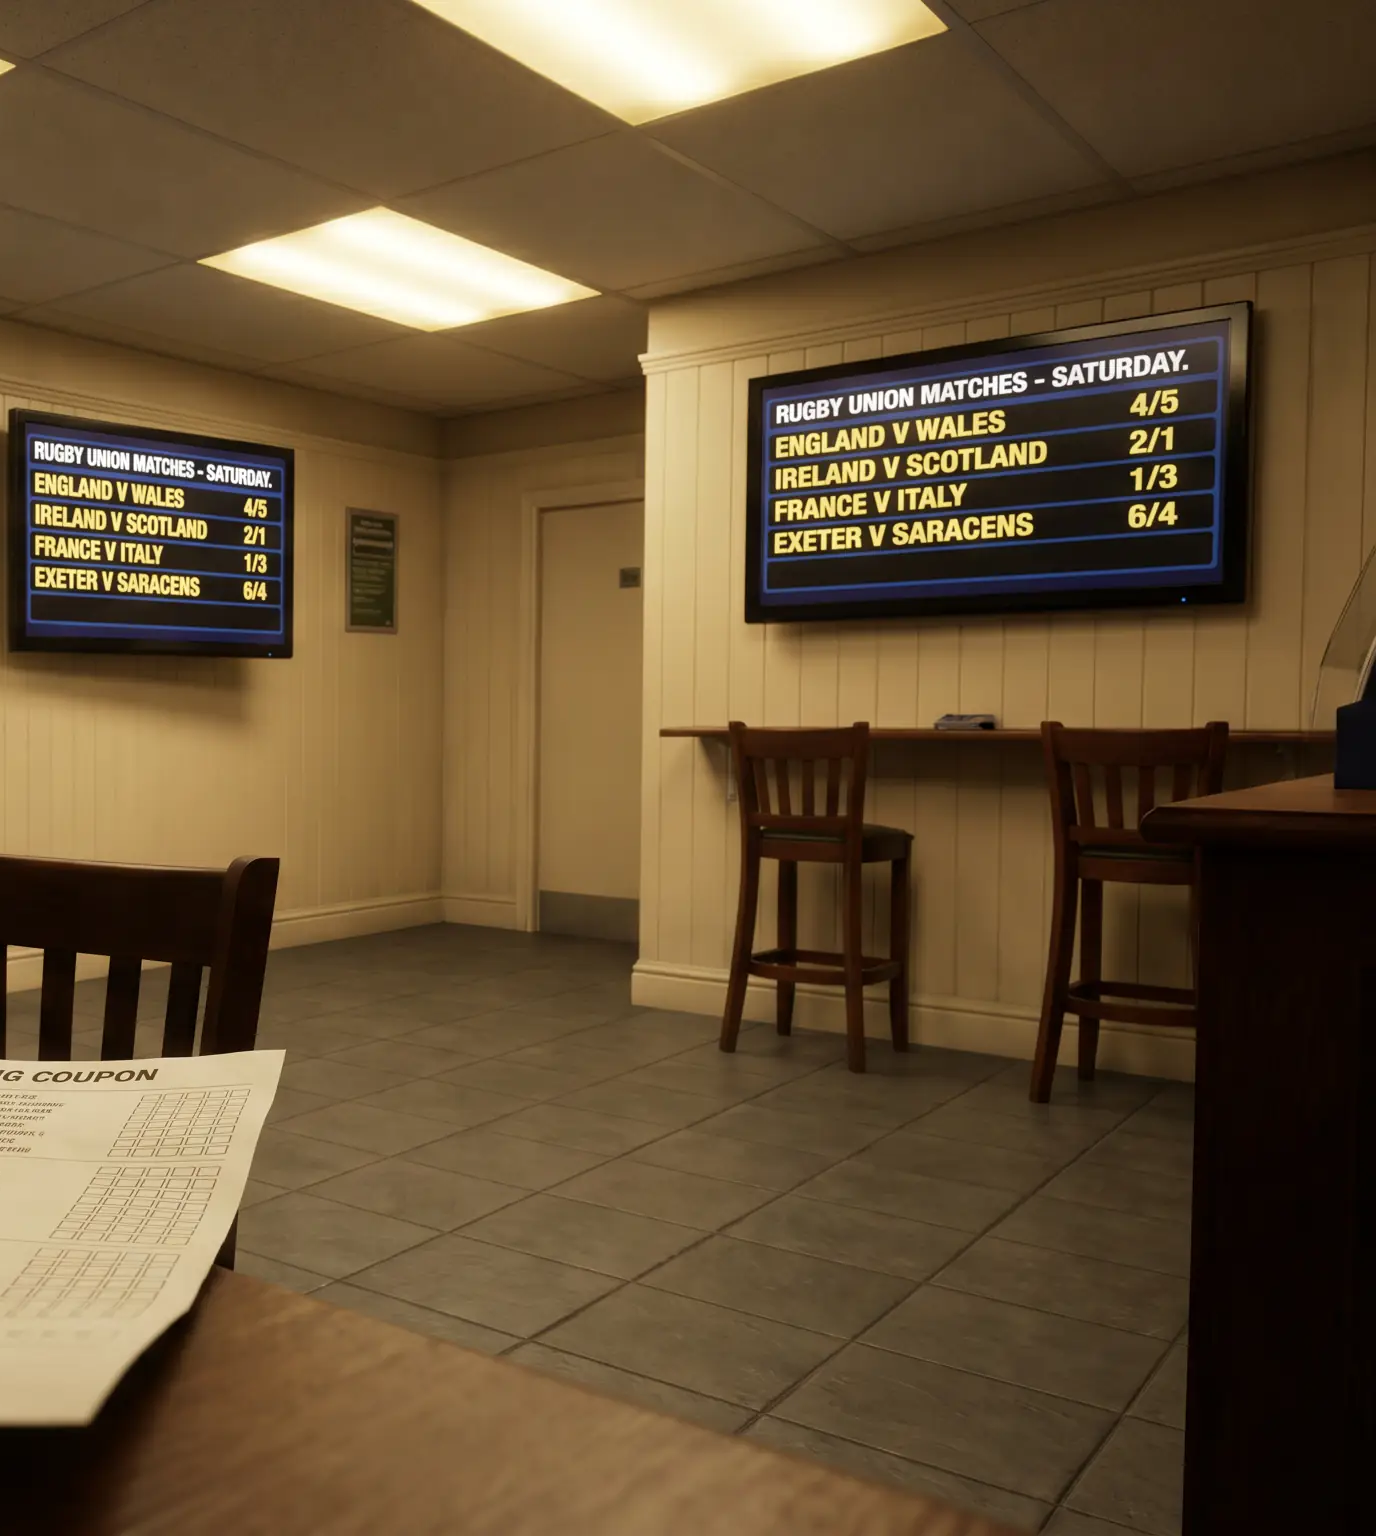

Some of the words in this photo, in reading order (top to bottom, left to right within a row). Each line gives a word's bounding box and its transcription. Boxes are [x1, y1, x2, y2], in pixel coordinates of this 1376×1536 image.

[776, 397, 843, 424] RUGBY
[849, 387, 914, 414] UNION
[921, 372, 1028, 405] MATCHES
[1052, 349, 1188, 387] SATURDAY.
[776, 425, 885, 458] ENGLAND
[892, 421, 910, 444] V
[916, 410, 1005, 441] WALES
[1130, 389, 1178, 416] 4/5
[34, 441, 84, 464] RUGBY
[87, 448, 130, 470] UNION
[133, 454, 195, 478] MATCHES
[206, 464, 272, 488] SATURDAY.
[775, 459, 876, 490] IRELAND
[883, 456, 900, 478] V
[906, 441, 1047, 476] SCOTLAND
[1129, 427, 1173, 454] 2/1
[35, 472, 113, 500] ENGLAND
[116, 481, 128, 502] V
[131, 483, 184, 508] WALES
[244, 498, 267, 518] 4/5
[775, 493, 867, 522] FRANCE
[874, 490, 891, 513] V
[898, 483, 967, 511] ITALY
[1130, 464, 1177, 491] 1/3
[35, 504, 107, 530] IRELAND
[111, 511, 122, 531] V
[126, 513, 207, 539] SCOTLAND
[244, 525, 265, 545] 2/1
[774, 527, 862, 554] EXETER
[869, 524, 886, 546] V
[892, 513, 1033, 545] SARACENS
[1128, 501, 1178, 528] 6/4
[35, 535, 101, 560] FRANCE
[104, 541, 117, 561] V
[121, 542, 163, 564] ITALY
[244, 553, 267, 573] 1/3
[35, 566, 98, 590] EXETER
[102, 571, 113, 591] V
[117, 572, 200, 597] SARACENS
[243, 581, 267, 600] 6/4
[32, 1068, 159, 1083] COUPON
